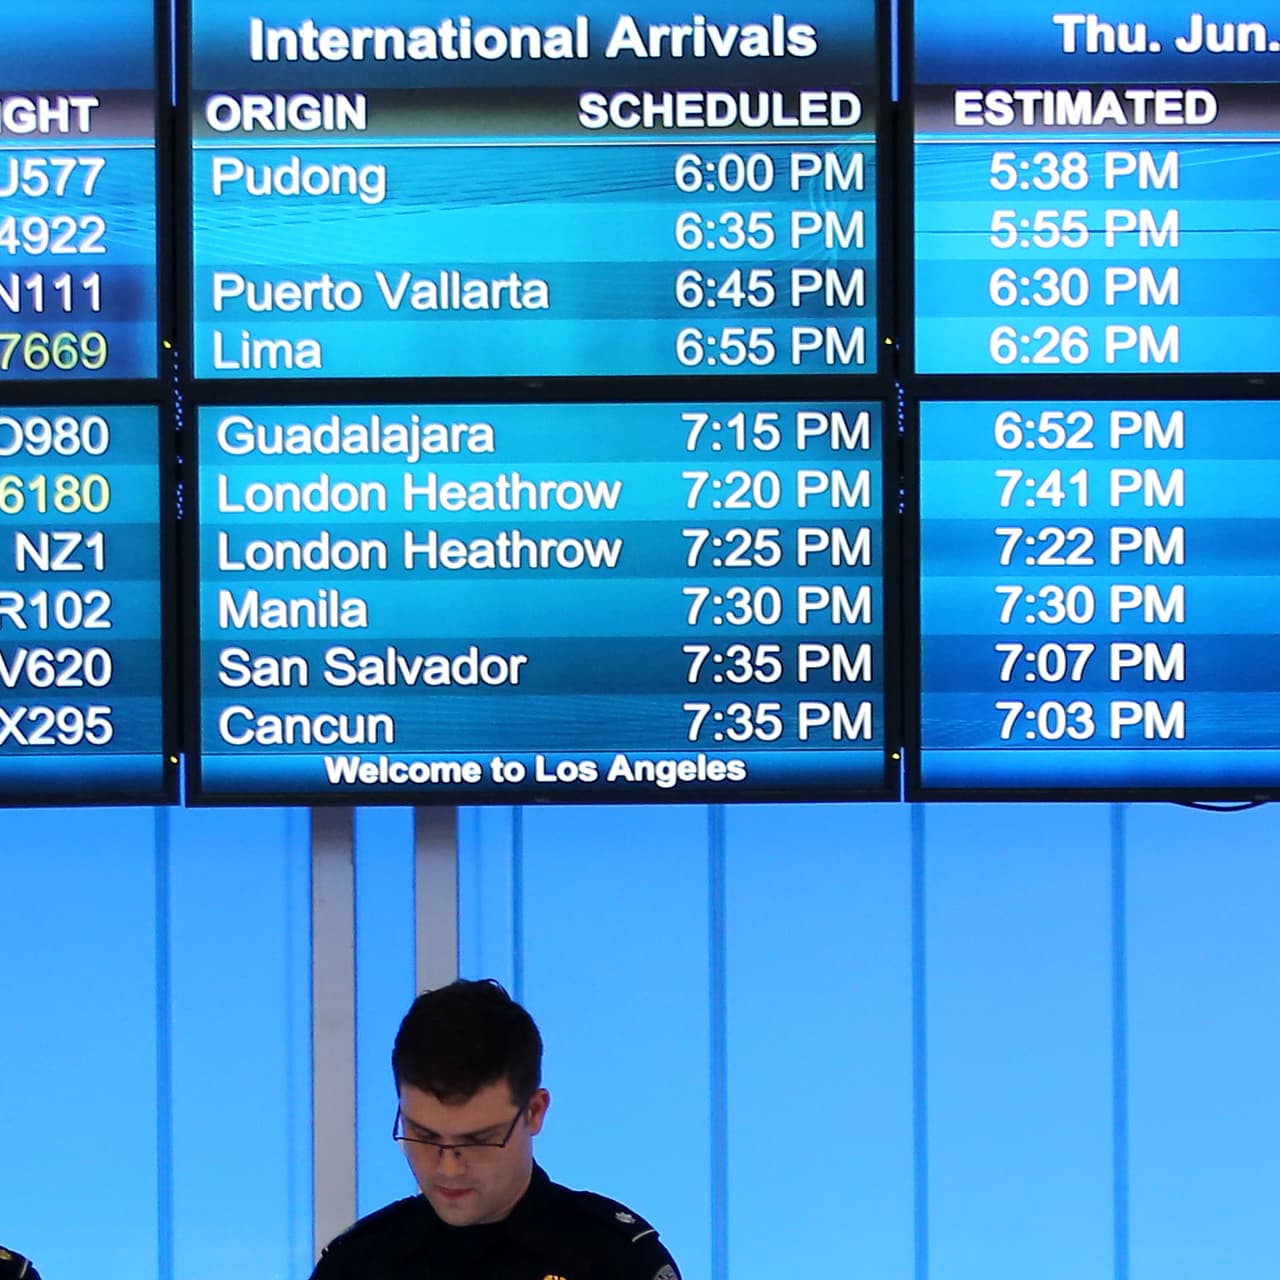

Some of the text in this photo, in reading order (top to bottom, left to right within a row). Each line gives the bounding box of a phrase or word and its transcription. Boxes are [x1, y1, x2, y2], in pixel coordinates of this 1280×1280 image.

[250, 13, 817, 61] International Arrivals
[1052, 13, 1161, 53] Thu.
[1175, 13, 1280, 53] Jun.
[205, 94, 366, 132] ORIGIN
[578, 91, 861, 129] SCHEDULED
[954, 89, 1217, 130] ESTIMATED
[212, 155, 386, 204] Pudong
[675, 151, 864, 192] 6:00 PM
[989, 150, 1179, 191] 5:38 PM
[675, 210, 864, 250] 6:35 PM
[989, 208, 1179, 249] 5:55 PM
[213, 270, 549, 312] Puerto Vallarta
[675, 268, 864, 308] 6:45 PM
[989, 266, 1179, 307] 6:30 PM
[213, 330, 322, 369] Lima
[676, 326, 865, 366] 6:55 PM
[989, 324, 1179, 365] 6:26 PM
[216, 414, 495, 463] Guadalajara
[681, 411, 870, 451] 7:15 PM
[994, 410, 1184, 450] 6:52 PM
[218, 471, 622, 513] London Heathrow
[682, 469, 870, 509] 7:20 PM
[995, 468, 1185, 507] 7:41 PM
[15, 531, 104, 572] NZ1
[218, 529, 623, 571] London Heathrow
[682, 527, 871, 567] 7:25 PM
[995, 526, 1185, 566] 7:22 PM
[219, 589, 368, 629] Manila
[682, 585, 871, 625] 7:30 PM
[995, 584, 1185, 624] 7:30 PM
[218, 646, 528, 687] San Salvador
[683, 643, 871, 683] 7:35 PM
[995, 642, 1185, 682] 7:07 PM
[219, 705, 394, 745] Cancun
[683, 701, 872, 741] 7:35 PM
[995, 700, 1185, 740] 7:03 PM
[323, 753, 747, 788] Welcome to Los Angeles
